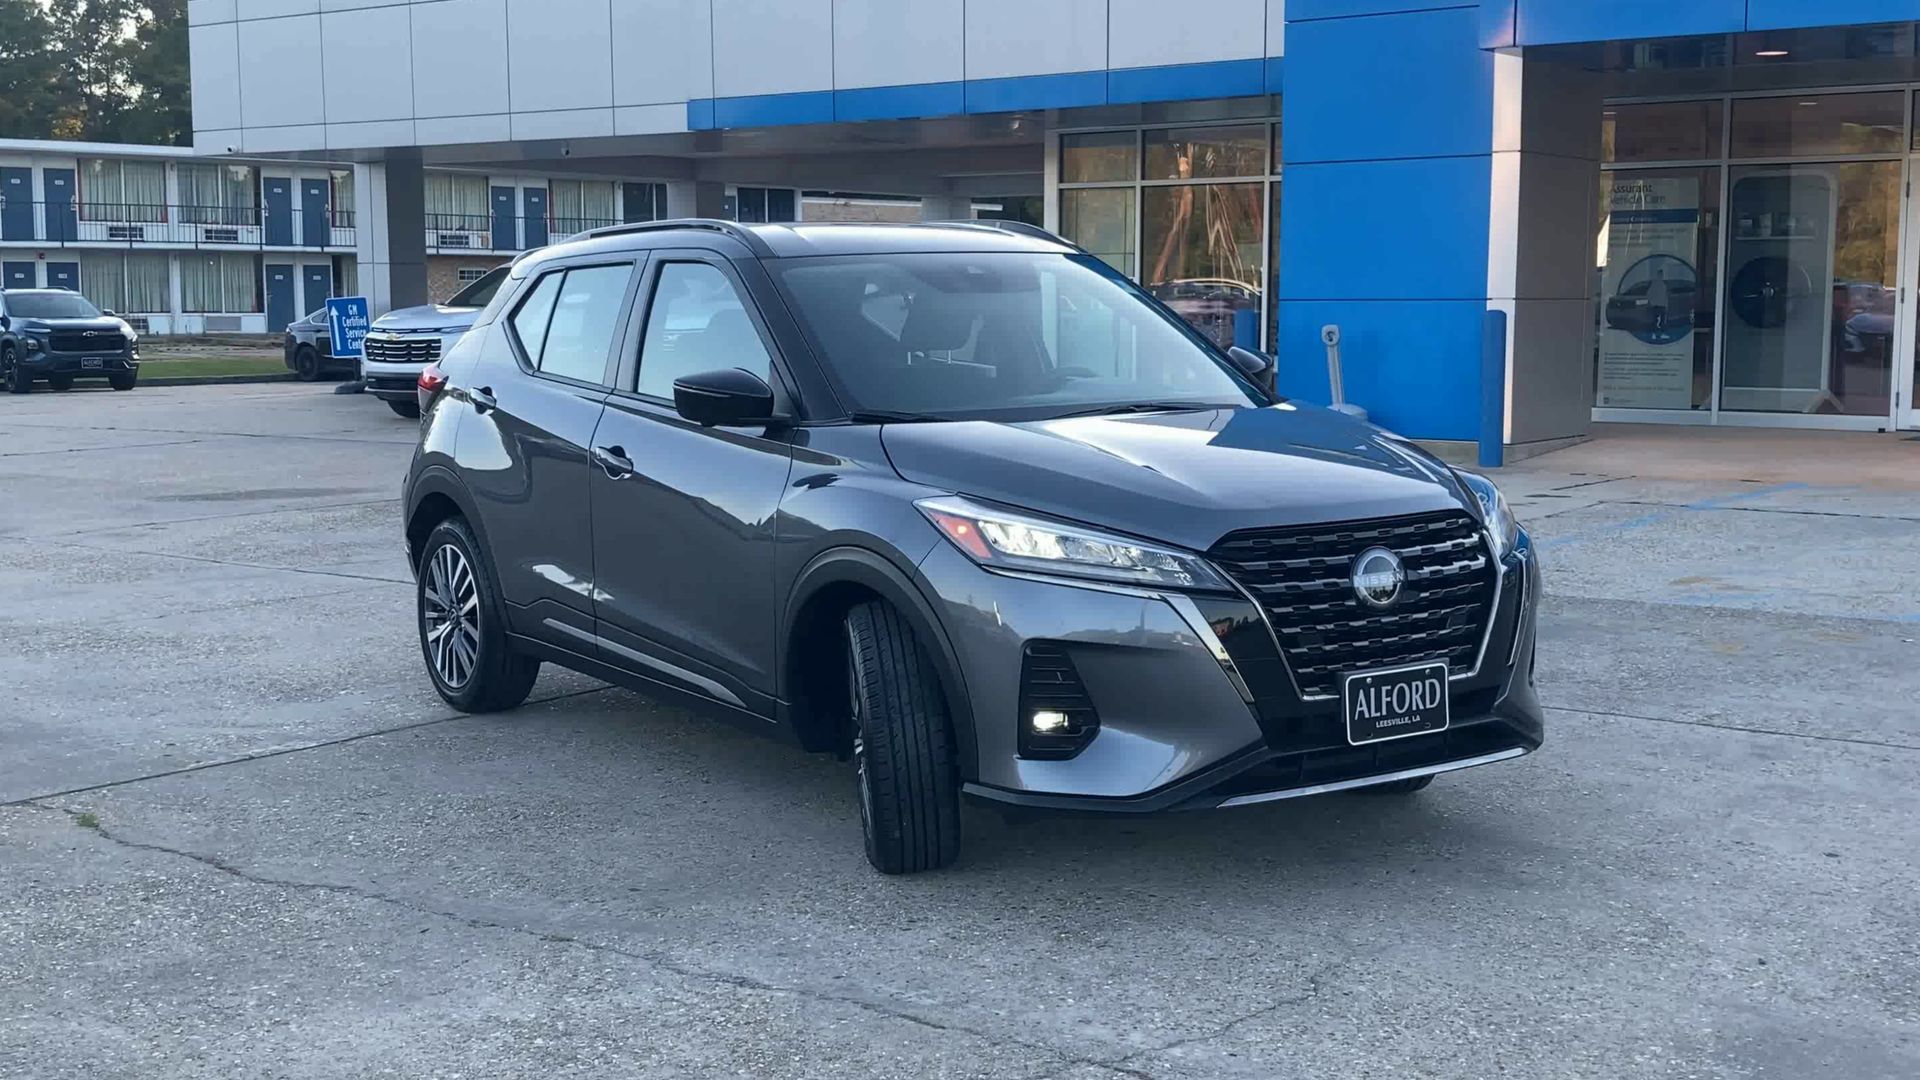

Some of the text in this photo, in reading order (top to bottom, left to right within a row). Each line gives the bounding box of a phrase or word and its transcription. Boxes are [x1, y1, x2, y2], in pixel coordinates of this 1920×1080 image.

[348, 304, 357, 315] GM
[342, 315, 367, 327] Certified
[345, 327, 366, 338] Service
[348, 339, 362, 350] Cent
[1354, 572, 1403, 587] NISSAN
[1354, 679, 1441, 720] ALFORD
[1376, 716, 1411, 728] LEESVILLE,
